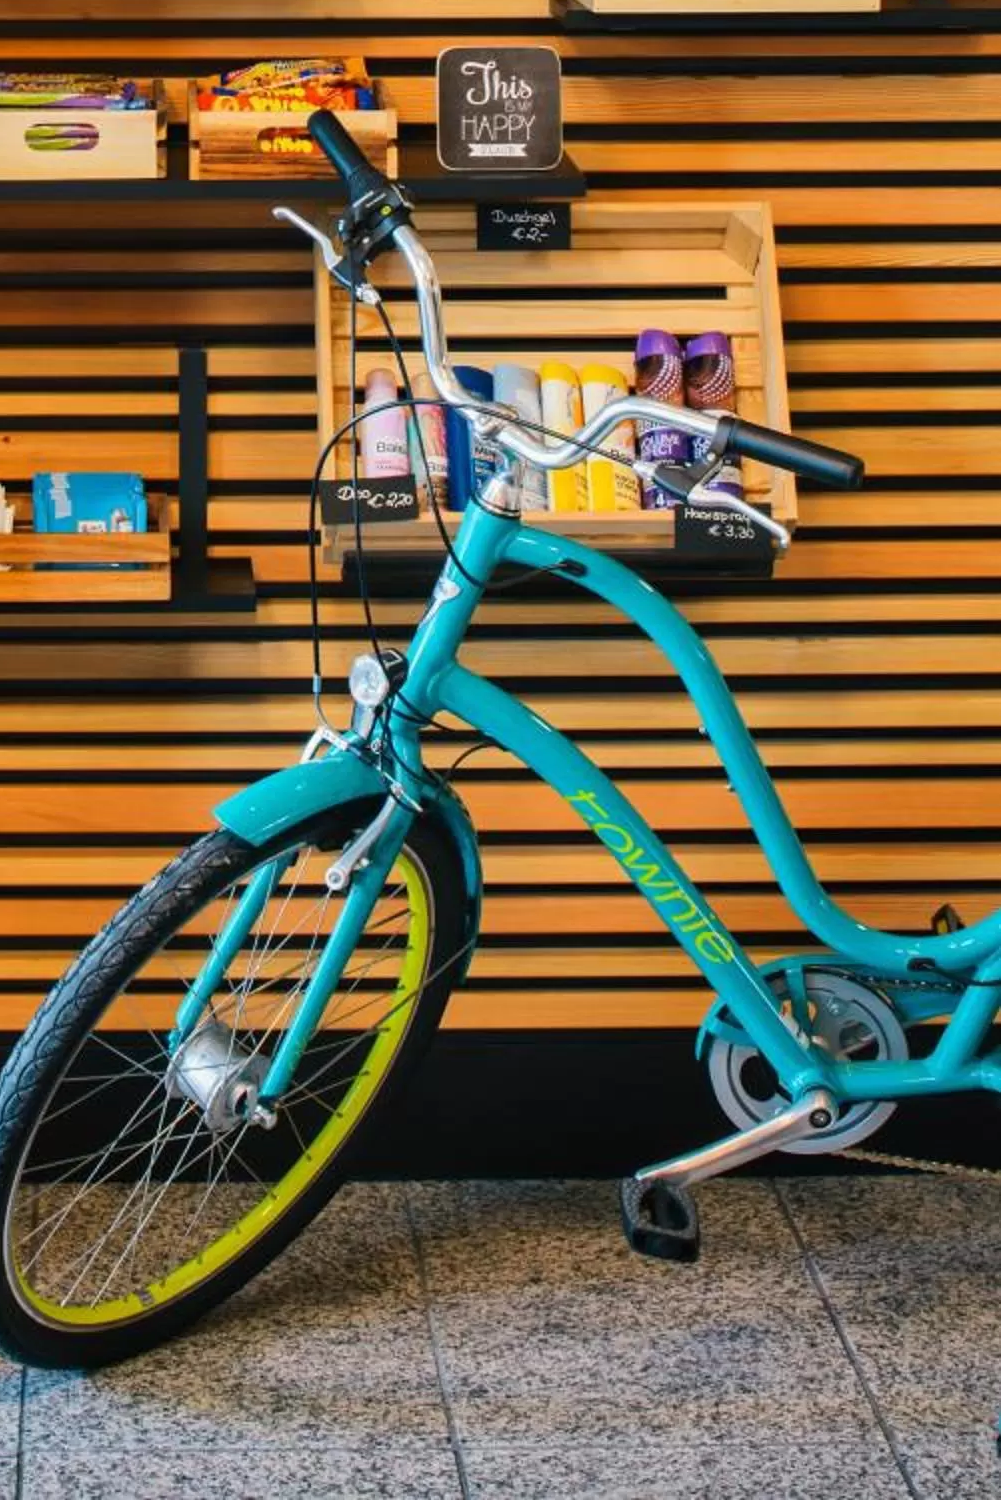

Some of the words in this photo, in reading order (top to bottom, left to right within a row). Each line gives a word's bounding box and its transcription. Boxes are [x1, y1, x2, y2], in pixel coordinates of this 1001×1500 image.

[460, 60, 534, 106] This
[460, 114, 536, 141] HAPPY
[491, 209, 557, 227] Duschgel
[564, 788, 734, 965] townie
